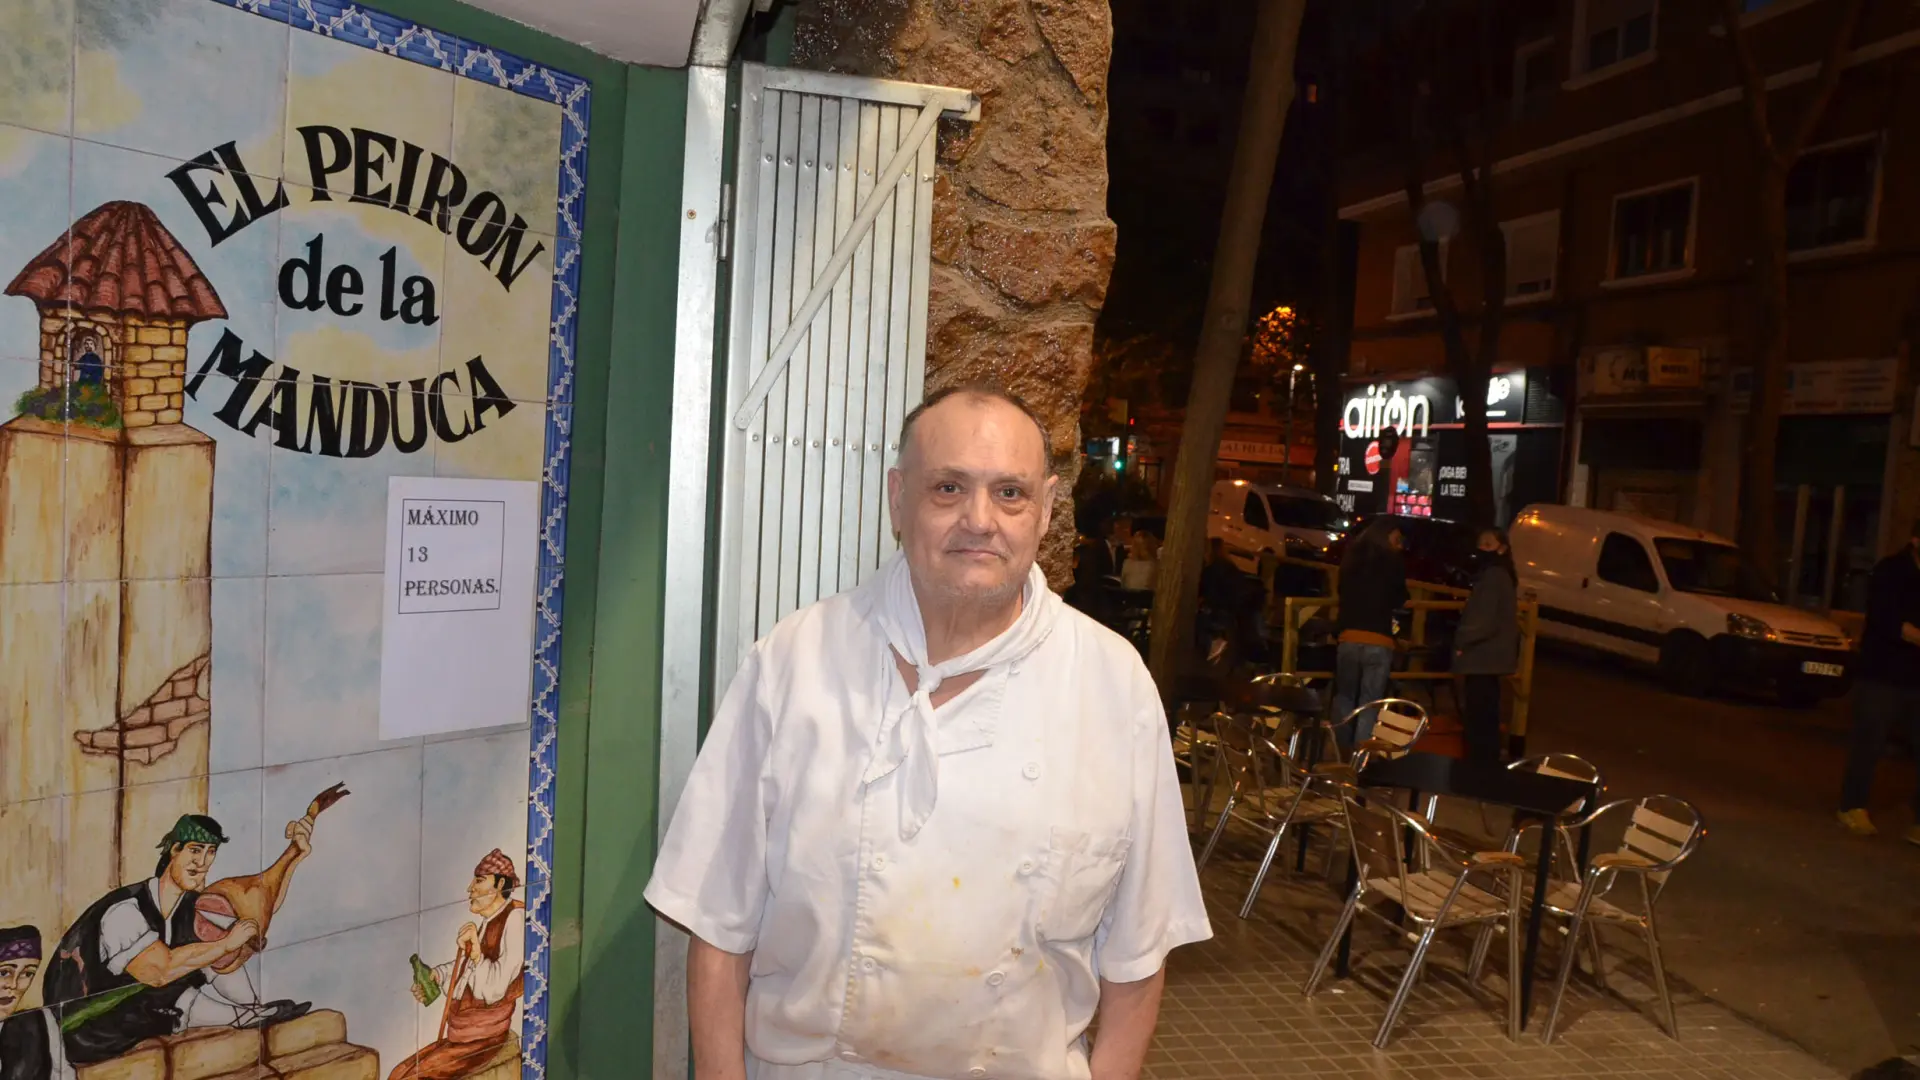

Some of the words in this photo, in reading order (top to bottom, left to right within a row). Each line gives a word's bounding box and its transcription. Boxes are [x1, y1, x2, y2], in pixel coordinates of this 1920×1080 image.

[165, 140, 289, 248] EL
[296, 125, 546, 293] PEIRON
[278, 232, 364, 317] de
[380, 245, 440, 327] la
[184, 327, 517, 458] MANDUCA
[407, 505, 479, 526] MÁXIMO
[408, 546, 429, 563] 13
[404, 578, 500, 597] PERSONAS.
